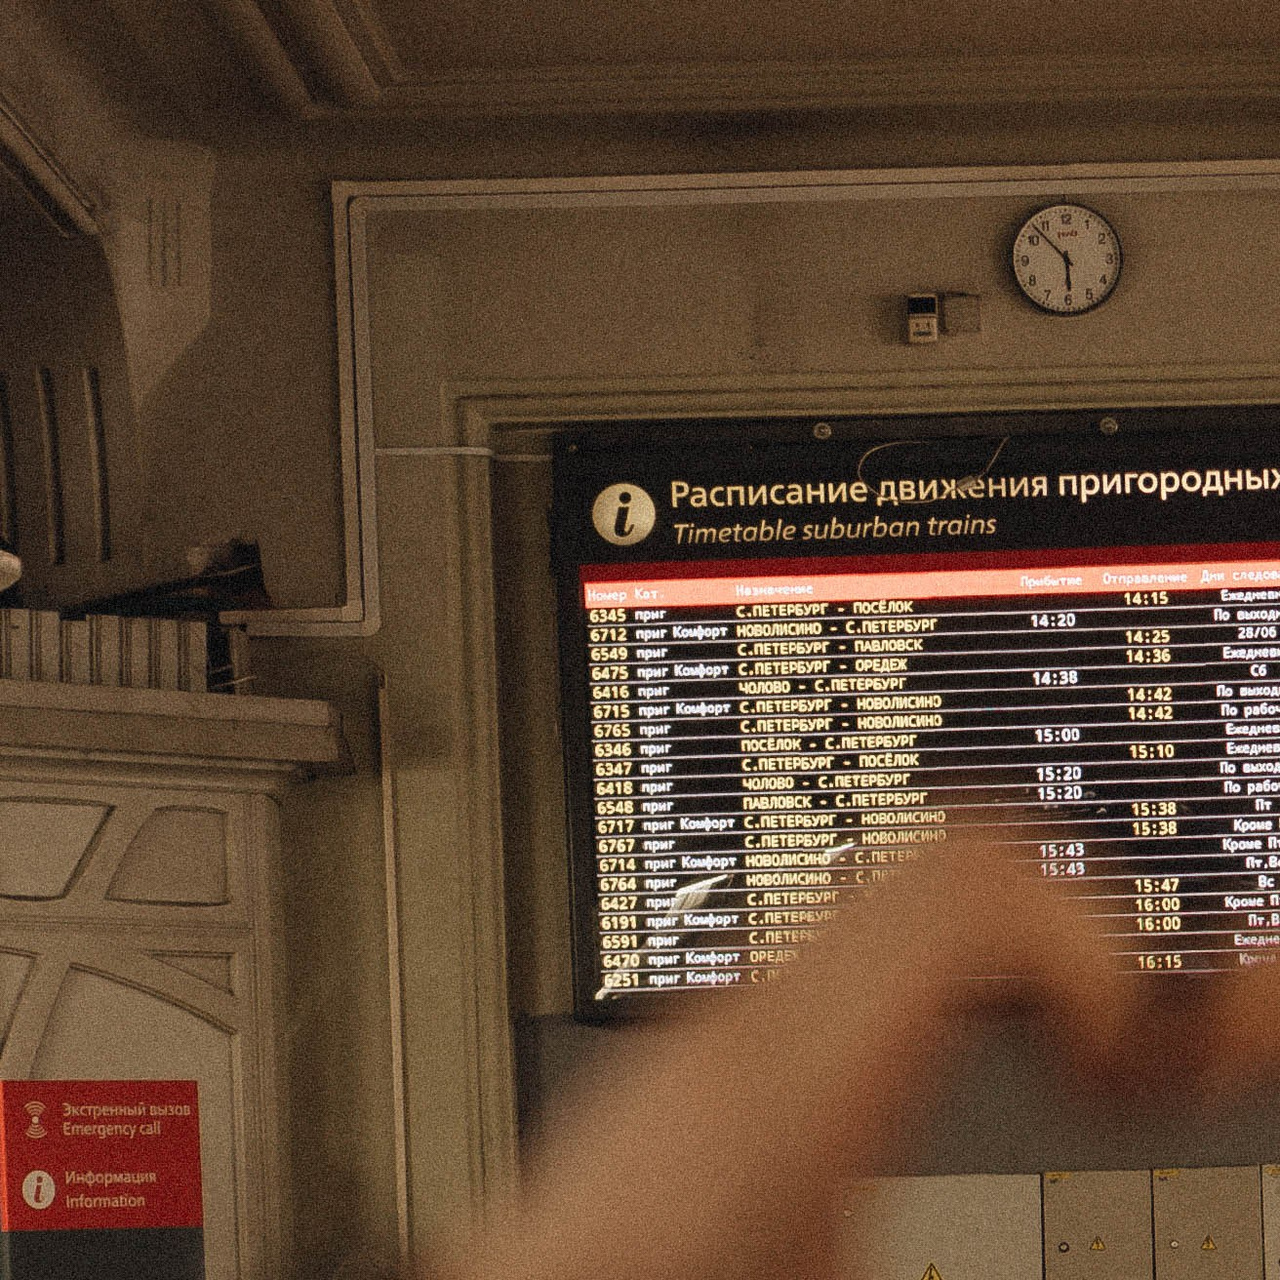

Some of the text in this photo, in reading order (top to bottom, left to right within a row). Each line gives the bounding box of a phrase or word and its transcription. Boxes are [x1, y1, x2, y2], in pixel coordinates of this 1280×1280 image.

[671, 477, 868, 508] Расписание
[877, 475, 1048, 506] движения
[673, 513, 997, 545] Timetable suburban trains
[588, 588, 627, 602] Номер
[736, 584, 813, 596] Назначение
[1020, 574, 1082, 588] Прибытие
[1103, 571, 1188, 587] Отправление
[1201, 570, 1225, 584] Дни
[590, 607, 626, 622] 6345
[634, 608, 666, 623] приг
[736, 601, 829, 617] С.ПЕТЕРБУРГ
[853, 596, 913, 614] ПОСЁЛОК
[1124, 590, 1168, 605] 14:15
[590, 626, 627, 641] 6712
[635, 627, 667, 642] приг
[673, 623, 728, 641] Комфорт
[736, 620, 822, 637] НОВОЛИСИНО
[845, 617, 938, 633] С.ПЕТЕРБУРГ
[1031, 612, 1075, 627] 14:20
[1213, 607, 1231, 621] По
[591, 646, 628, 660] 6549
[737, 639, 830, 656] С.ПЕТЕРБУРГ
[854, 636, 923, 652] ПАВЛОВСК
[1126, 628, 1170, 643] 14:25
[1238, 625, 1277, 642] 28/06
[592, 665, 628, 680] 6475
[637, 666, 669, 680] приг
[674, 662, 729, 679] Комфорт
[738, 658, 831, 675] С.ПЕТЕРБУРГ
[855, 656, 907, 673] ОРЕДЕЖ
[1126, 647, 1171, 662] 14:36
[593, 663, 1267, 699] 6416 ЧОЛОВО С.ПЕТЕРБУРГ 14:38 Сб
[593, 703, 630, 718] 6715
[638, 704, 670, 718] приг
[675, 700, 731, 717] Комфорт
[739, 697, 832, 713] С.ПЕТЕРБУРГ
[857, 693, 942, 709] НОВОЛИСИНО
[1127, 686, 1172, 701] 14:42
[594, 722, 631, 737] 6765
[740, 716, 833, 732] С.ПЕТЕРБУРГ
[857, 712, 943, 729] НОВОЛИСИНО
[1128, 705, 1173, 720] 14:42
[1220, 703, 1238, 717] По
[595, 727, 1080, 756] 6346 ПОСЁЛОК С.ПЕТЕРБУРГ 15:00
[596, 761, 632, 775] 6347
[741, 754, 835, 771] С.ПЕТЕРБУРГ
[859, 749, 919, 767] ПОСЁЛОК
[1129, 743, 1174, 758] 15:10
[596, 765, 1081, 795] 6418 ЧОЛОВО С.ПЕТЕРБУРГ 15:20
[597, 784, 1082, 814] 6548 ПАВЛОВСК С.ПЕТЕРБУРГ 15:20
[597, 818, 635, 833] 6717
[642, 819, 675, 834] приг
[680, 815, 735, 832] Комфорт
[744, 812, 837, 828] С.ПЕТЕРБУРГ
[861, 808, 946, 824] НОВОЛИСИНО
[1132, 800, 1176, 815] 15:38
[1255, 797, 1272, 811] Пт
[598, 838, 635, 852] 6767
[744, 831, 838, 847] С.ПЕТЕРБУРГ
[1133, 819, 1177, 834] 15:38
[1233, 816, 1273, 833] Кроме
[599, 836, 1262, 872] 6714 приг 15:43 Кроме
[600, 869, 831, 891] 6764 НОВОЛИСИНО
[600, 895, 637, 910] 6427
[1135, 877, 1179, 892] 15:47
[1258, 873, 1274, 887] Вс
[600, 914, 636, 929] 6191
[1136, 896, 1180, 911] 16:00
[1224, 893, 1264, 910] Кроме
[602, 934, 637, 948] 6591
[1137, 915, 1181, 930] 16:00
[603, 953, 639, 967] 6470
[1138, 953, 1182, 968] 16:15
[62, 1102, 191, 1119] Экстренный вызов
[63, 1121, 161, 1139] Emergency call
[65, 1170, 157, 1187] Информация
[66, 1195, 145, 1208] Information
